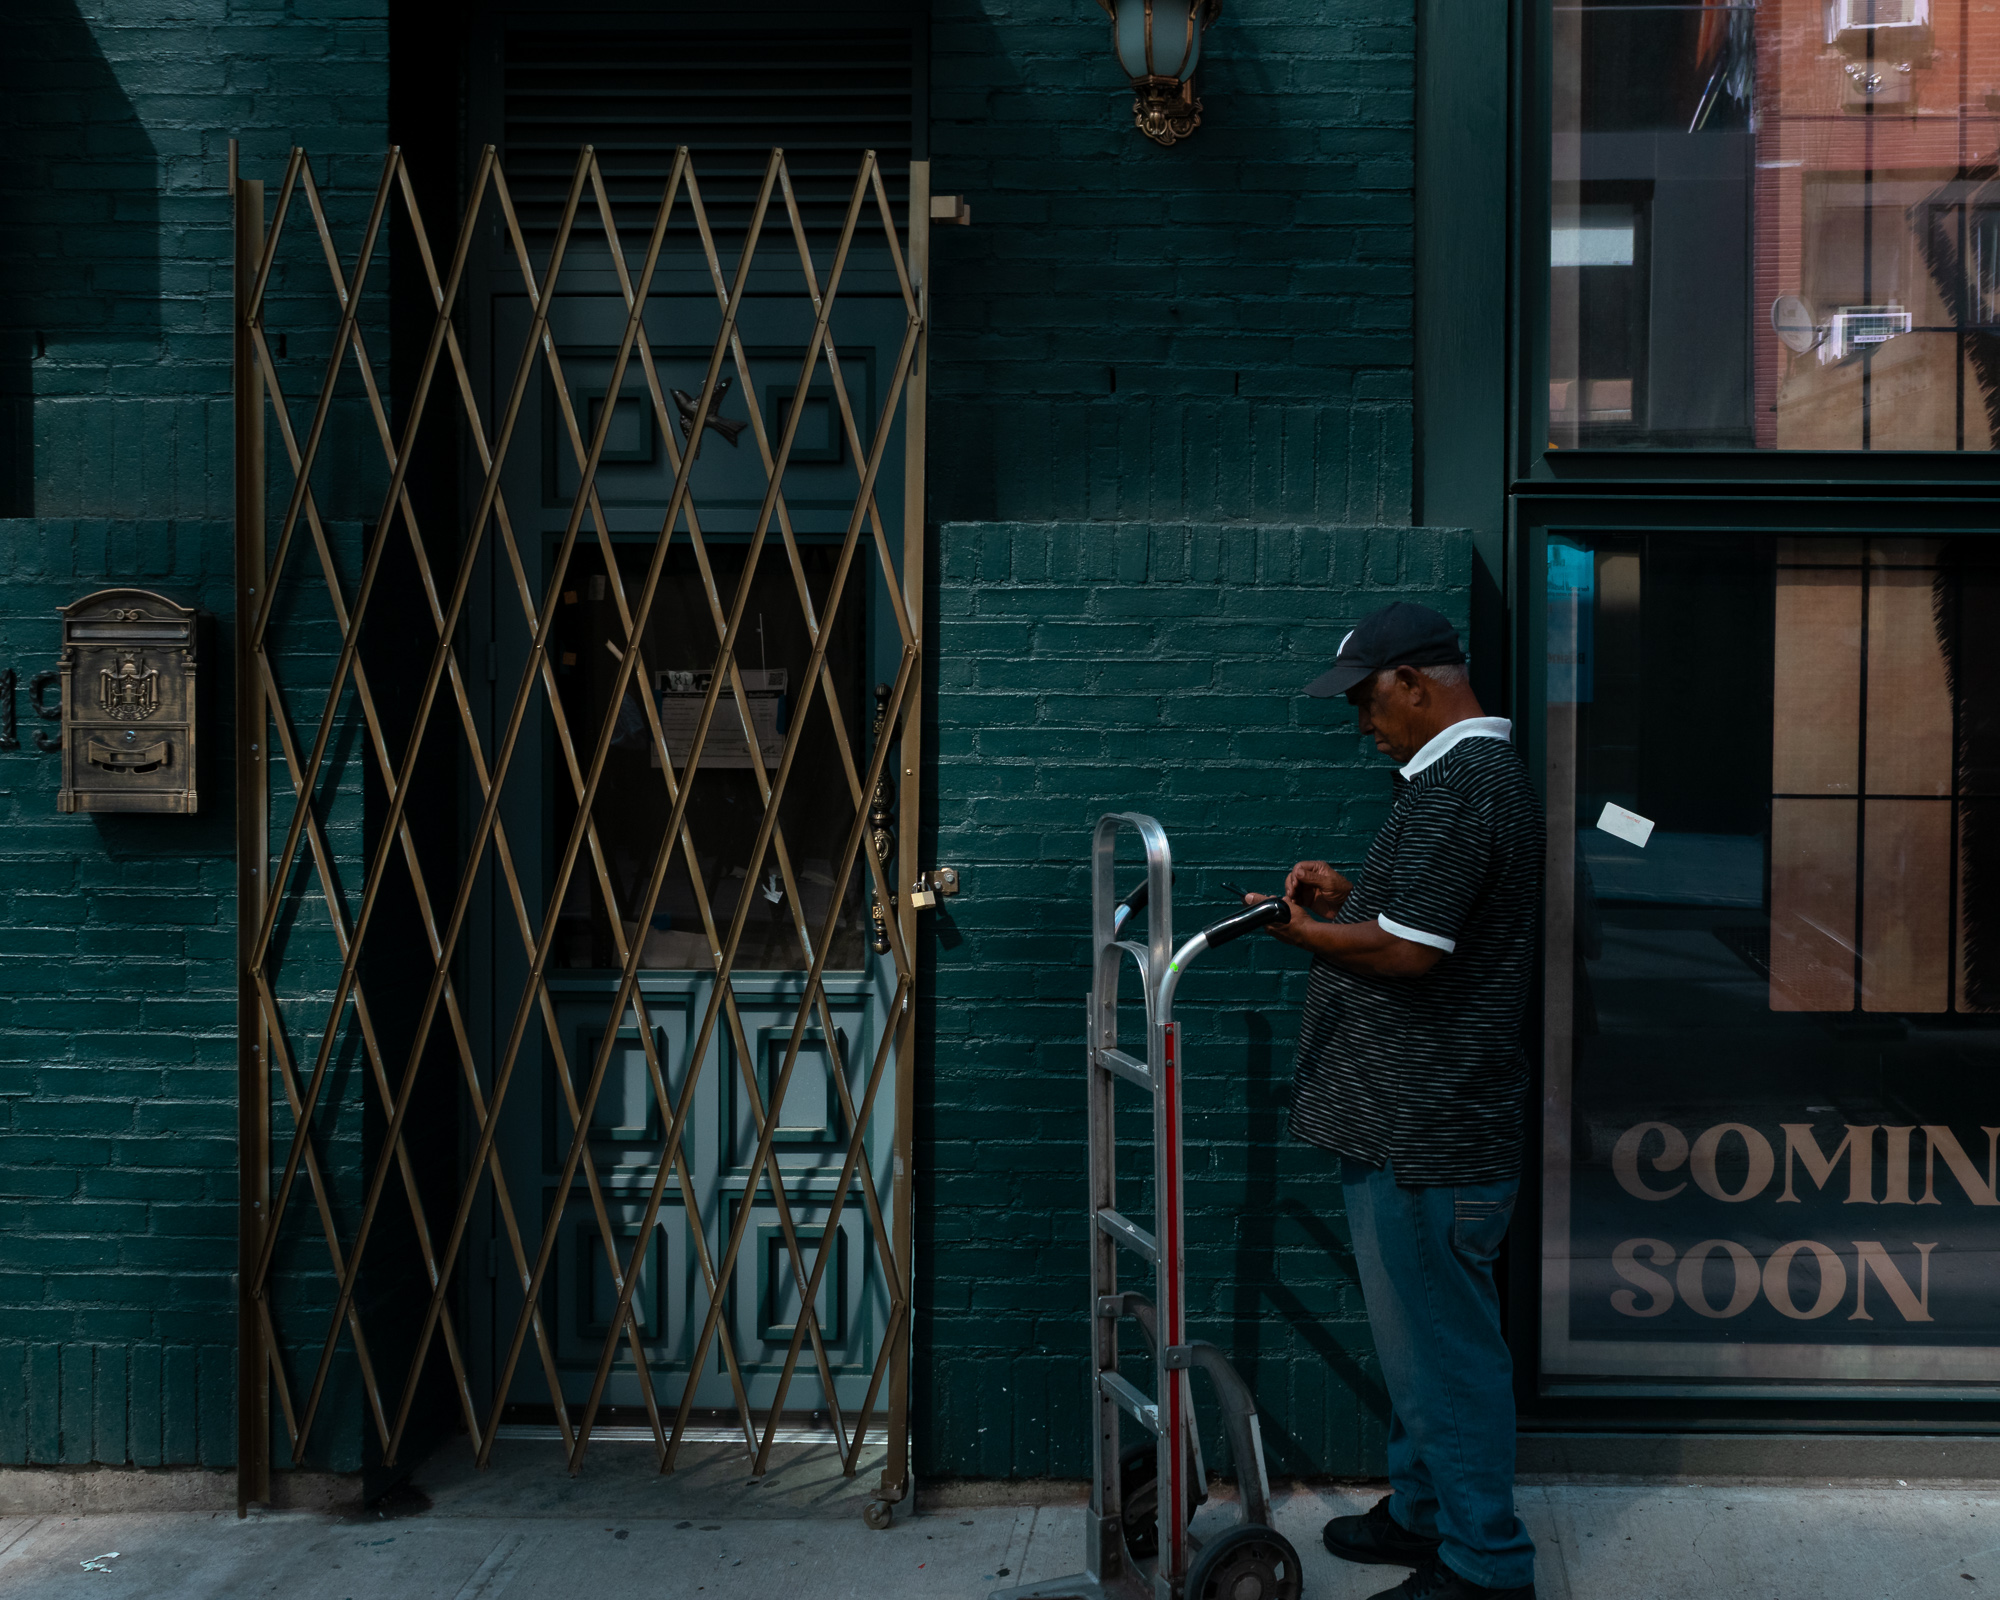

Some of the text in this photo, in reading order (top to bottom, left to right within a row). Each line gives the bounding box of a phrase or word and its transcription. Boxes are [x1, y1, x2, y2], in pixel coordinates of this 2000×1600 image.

[0, 667, 62, 753] 19
[1612, 1121, 2000, 1206] COMIN
[1610, 1238, 1938, 1321] SOON
